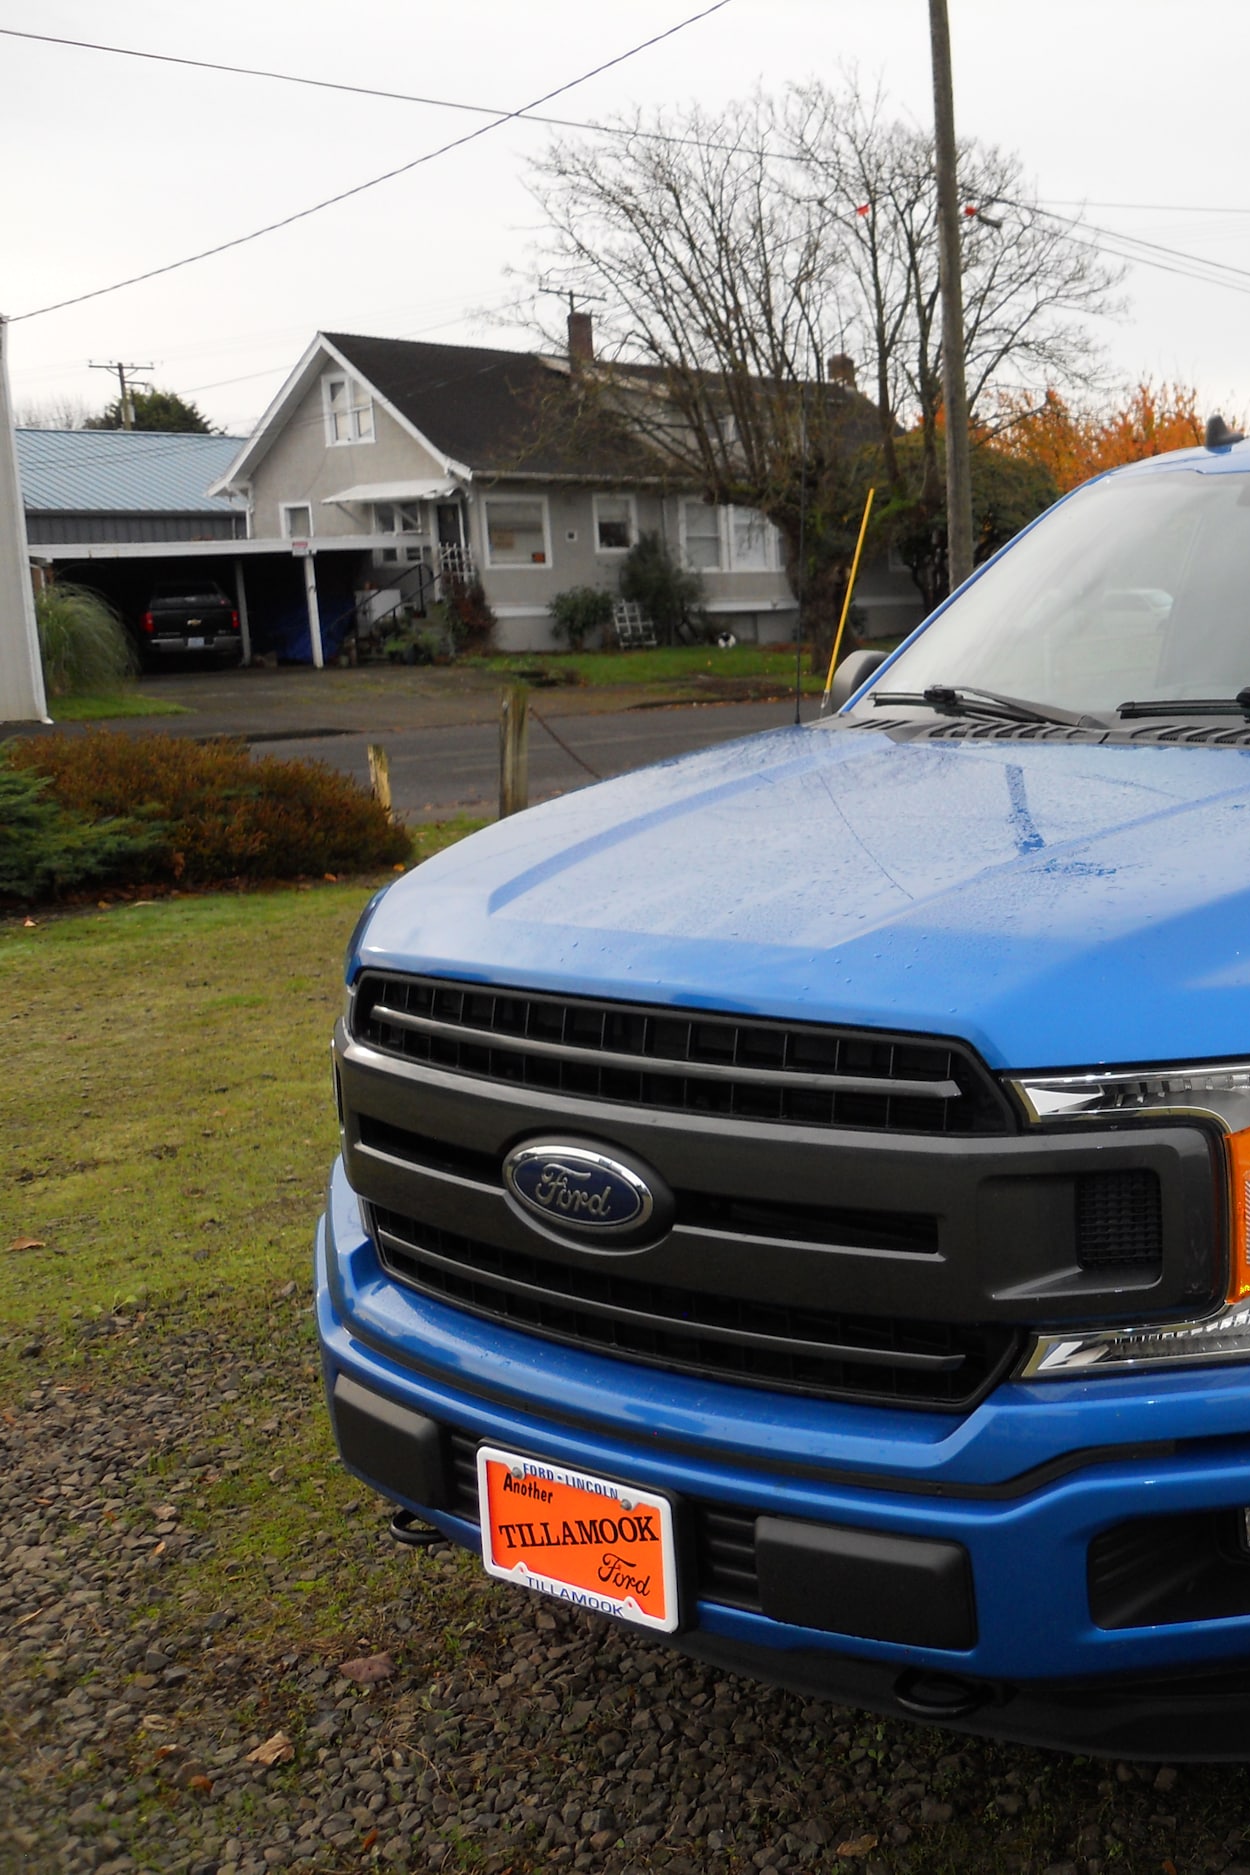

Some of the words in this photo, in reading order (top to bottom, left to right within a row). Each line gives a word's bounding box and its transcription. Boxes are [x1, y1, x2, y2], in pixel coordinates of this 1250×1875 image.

[535, 1163, 612, 1216] Ford
[503, 1473, 554, 1504] Another
[499, 1515, 660, 1549] TILLAMOOK
[597, 1552, 651, 1597] Ford
[525, 1575, 625, 1618] TILLAMOOK
